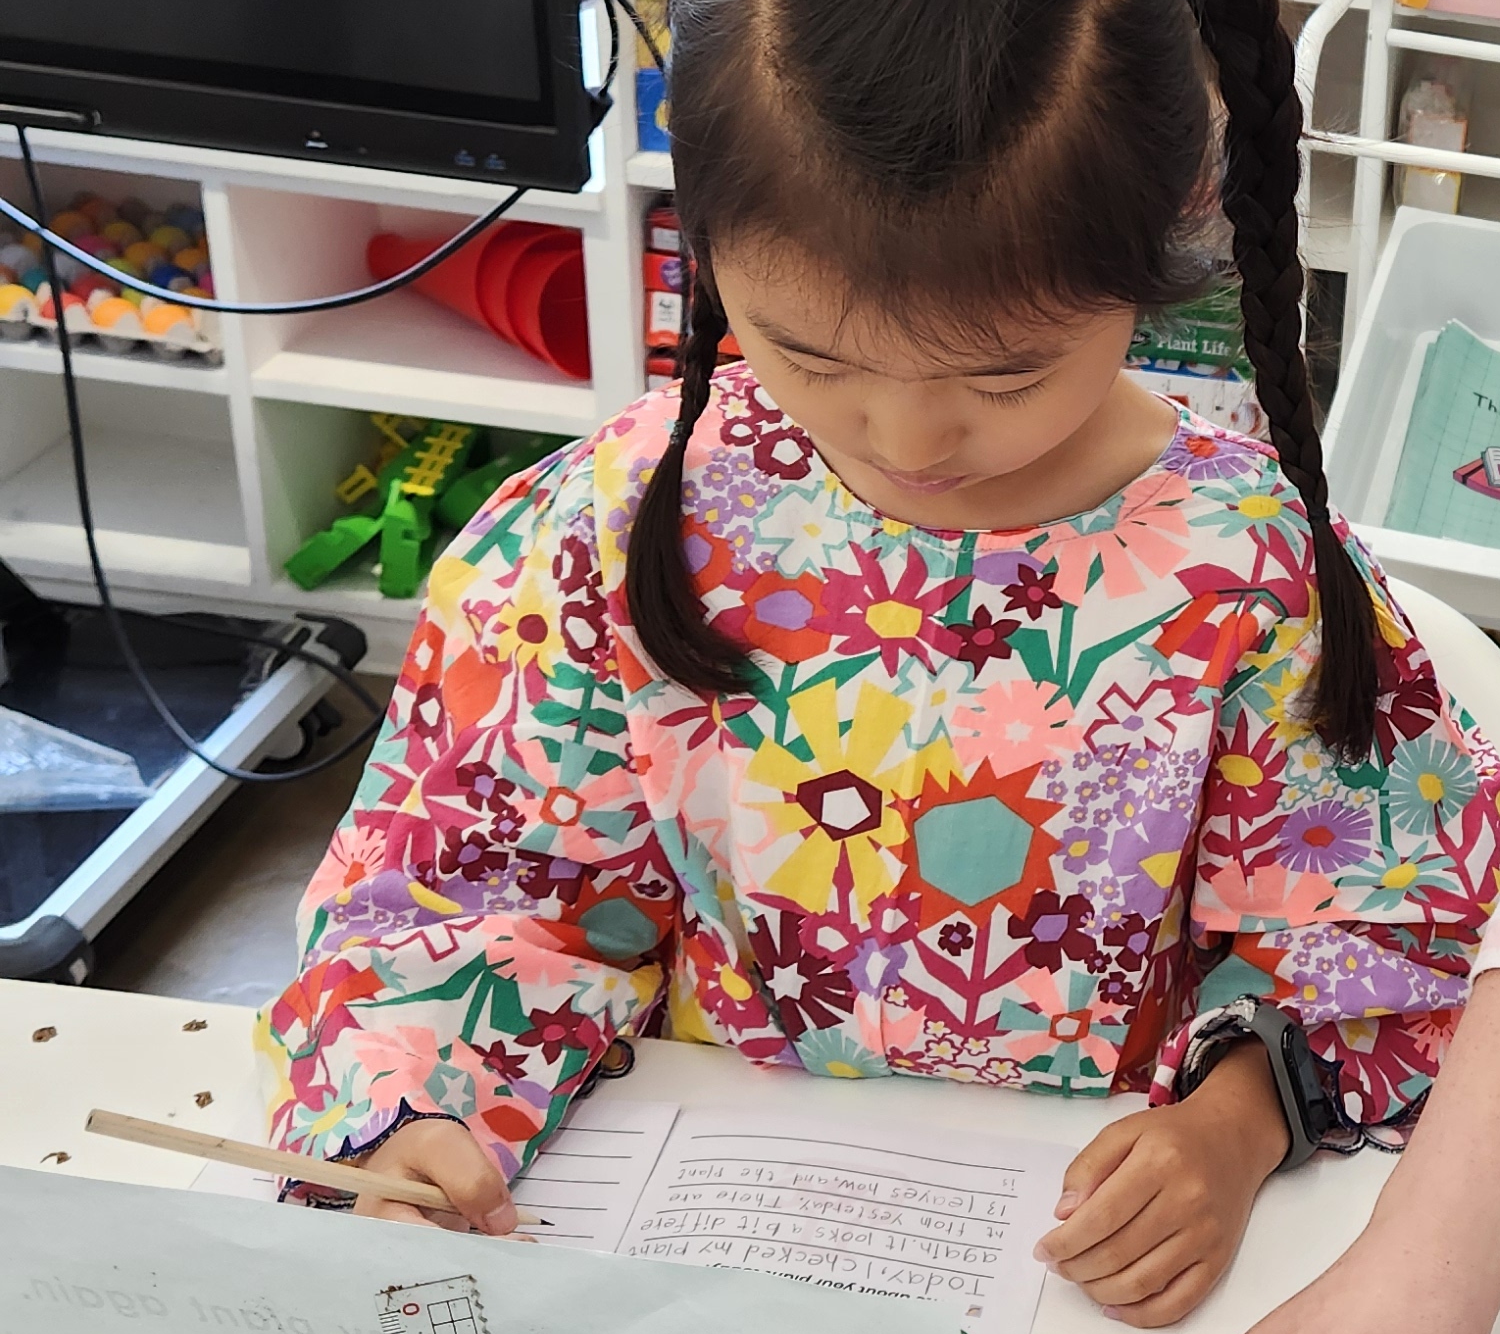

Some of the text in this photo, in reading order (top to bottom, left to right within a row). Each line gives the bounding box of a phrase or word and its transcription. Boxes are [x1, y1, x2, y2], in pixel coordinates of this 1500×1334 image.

[1158, 335, 1198, 353] Plant
[737, 1216, 781, 1237] bit
[698, 1239, 734, 1255] my
[814, 1227, 873, 1249] looks
[628, 1240, 690, 1257] plant
[748, 1244, 860, 1275] checked
